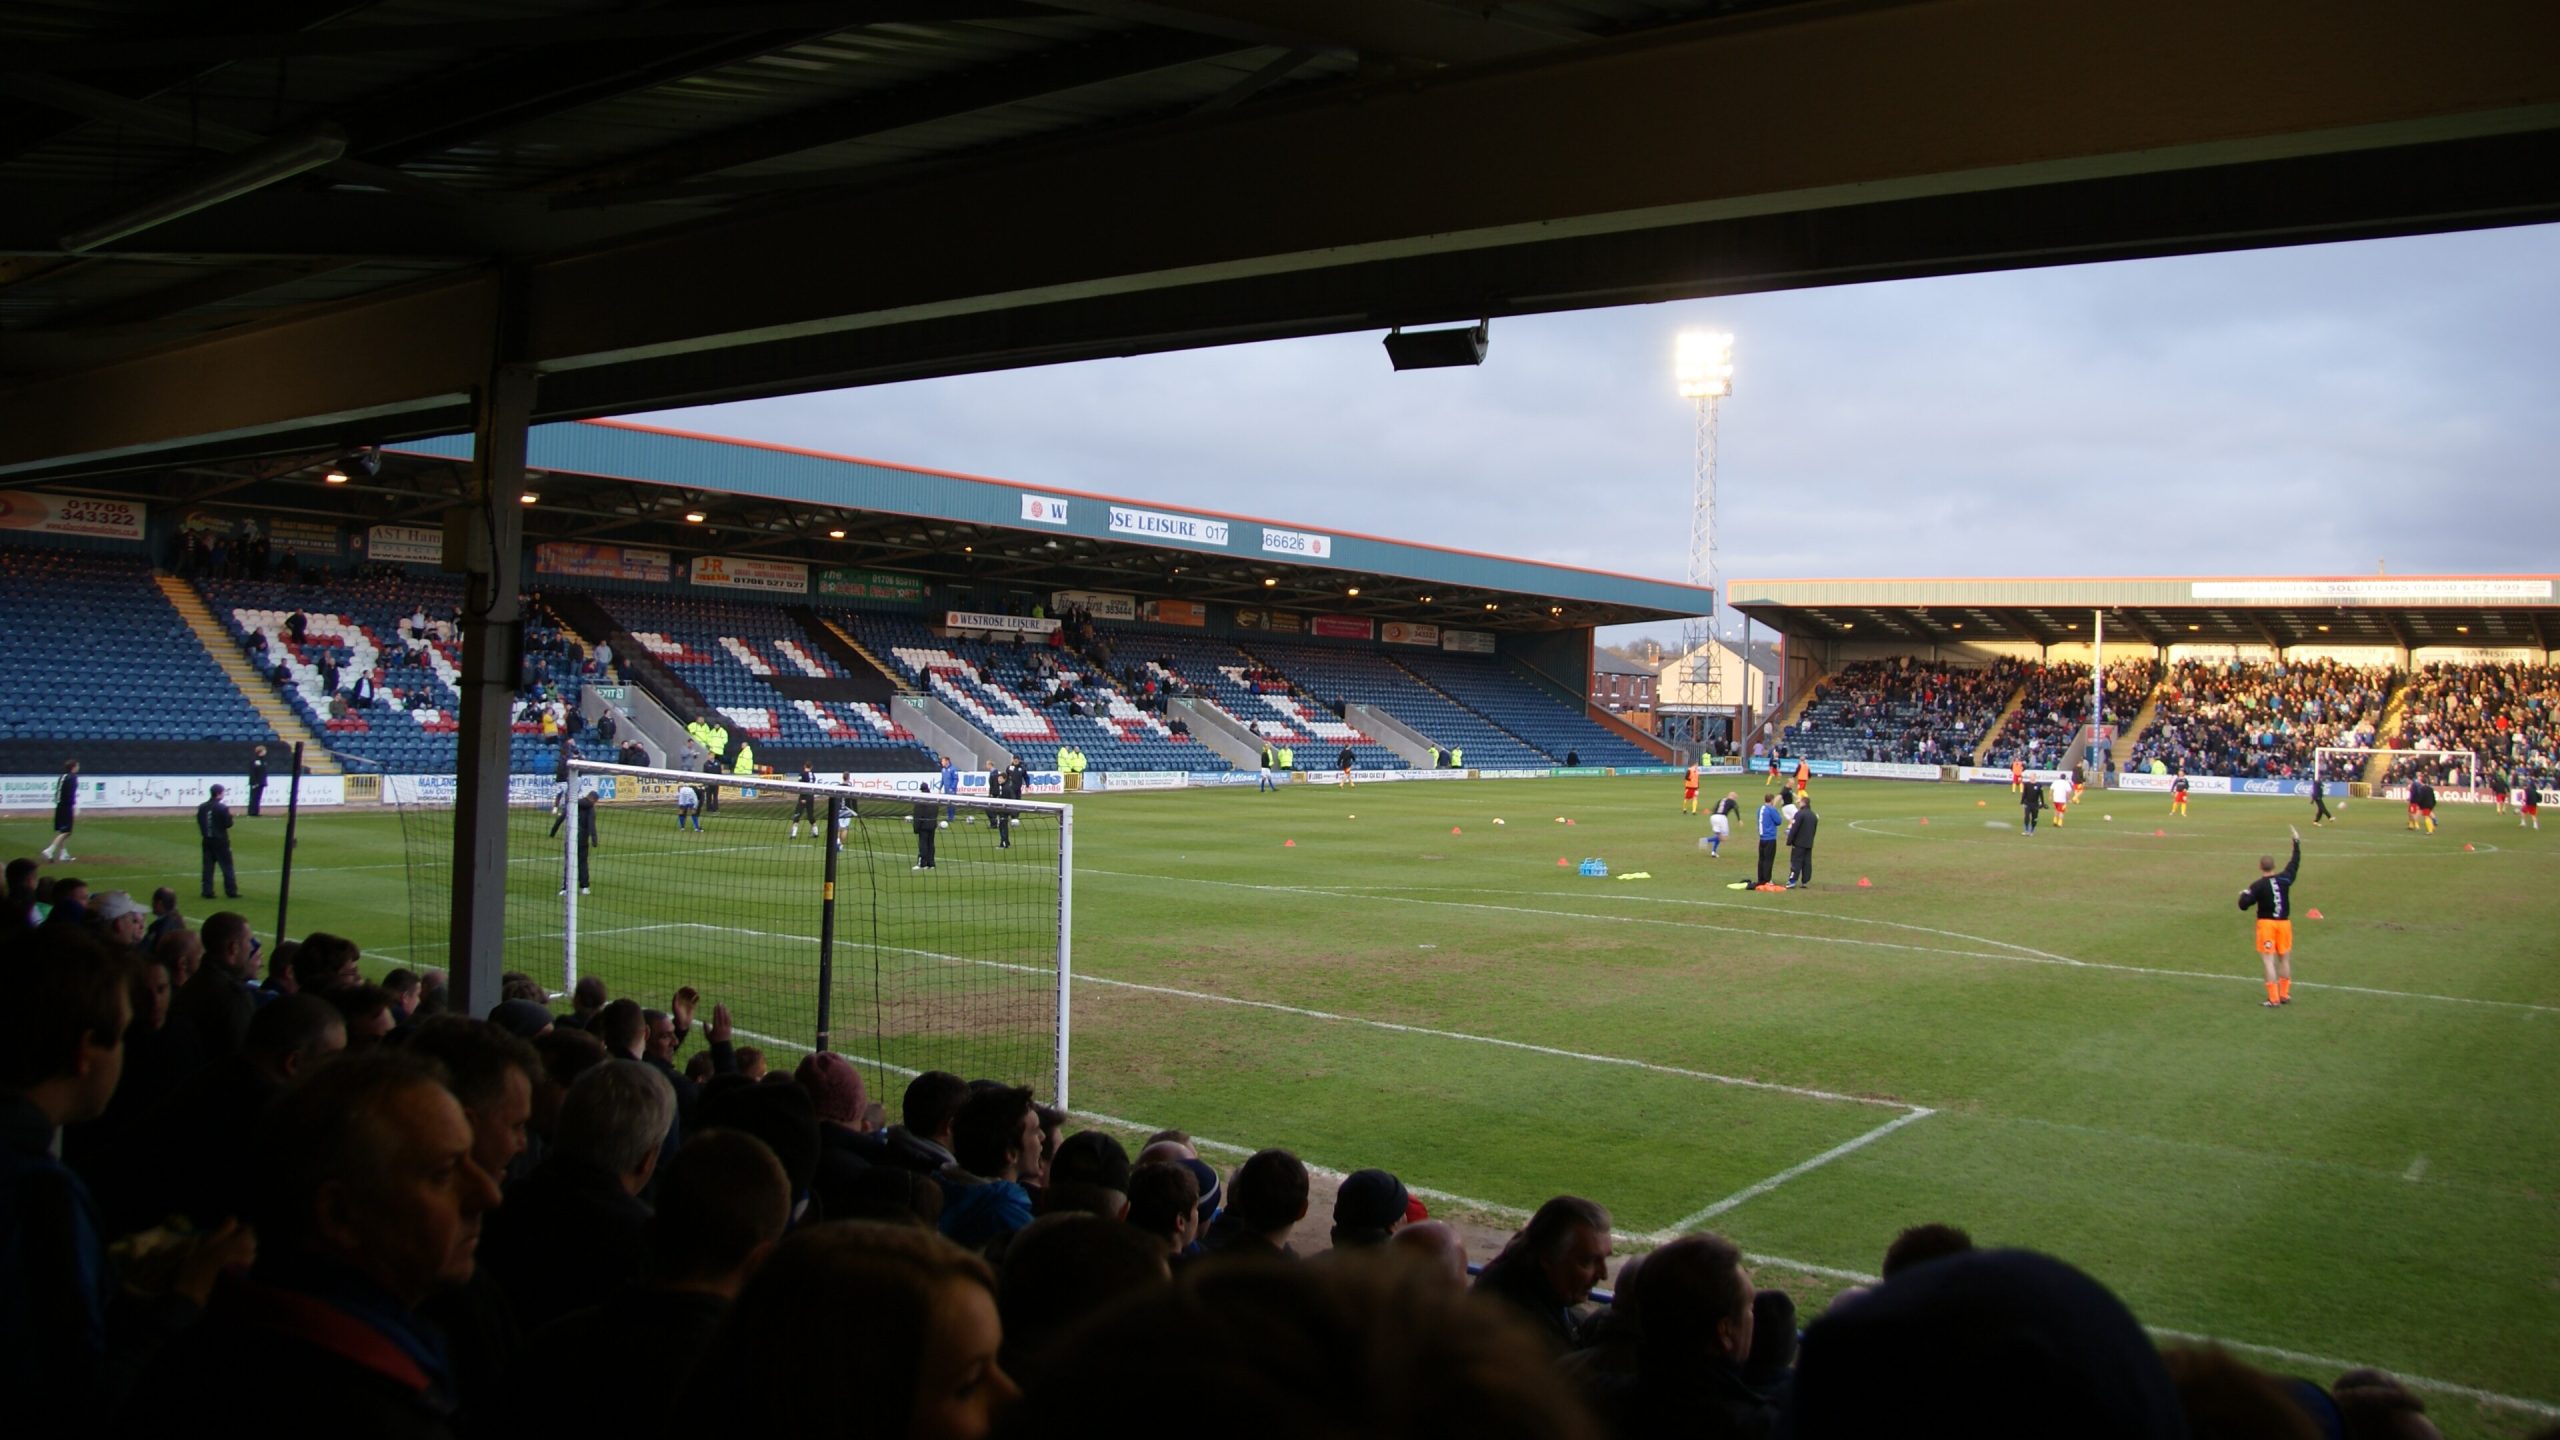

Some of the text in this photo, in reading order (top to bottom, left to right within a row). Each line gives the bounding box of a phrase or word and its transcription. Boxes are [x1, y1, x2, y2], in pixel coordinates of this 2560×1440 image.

[68, 500, 129, 514] 01706
[61, 508, 135, 526] 343322
[372, 528, 404, 540] AST
[1138, 518, 1196, 537] LEISURE
[1206, 525, 1228, 542] 017
[1262, 532, 1305, 551] 66626
[824, 571, 842, 581] The
[960, 613, 1004, 627] WESTROSE
[1008, 618, 1040, 630] LEISURE
[817, 777, 941, 791] fbets.cok
[1221, 772, 1258, 784] Options
[2121, 777, 2225, 789] freebetco.uk
[5, 782, 48, 791] BUILDING
[2244, 779, 2280, 793] Coca-Cola
